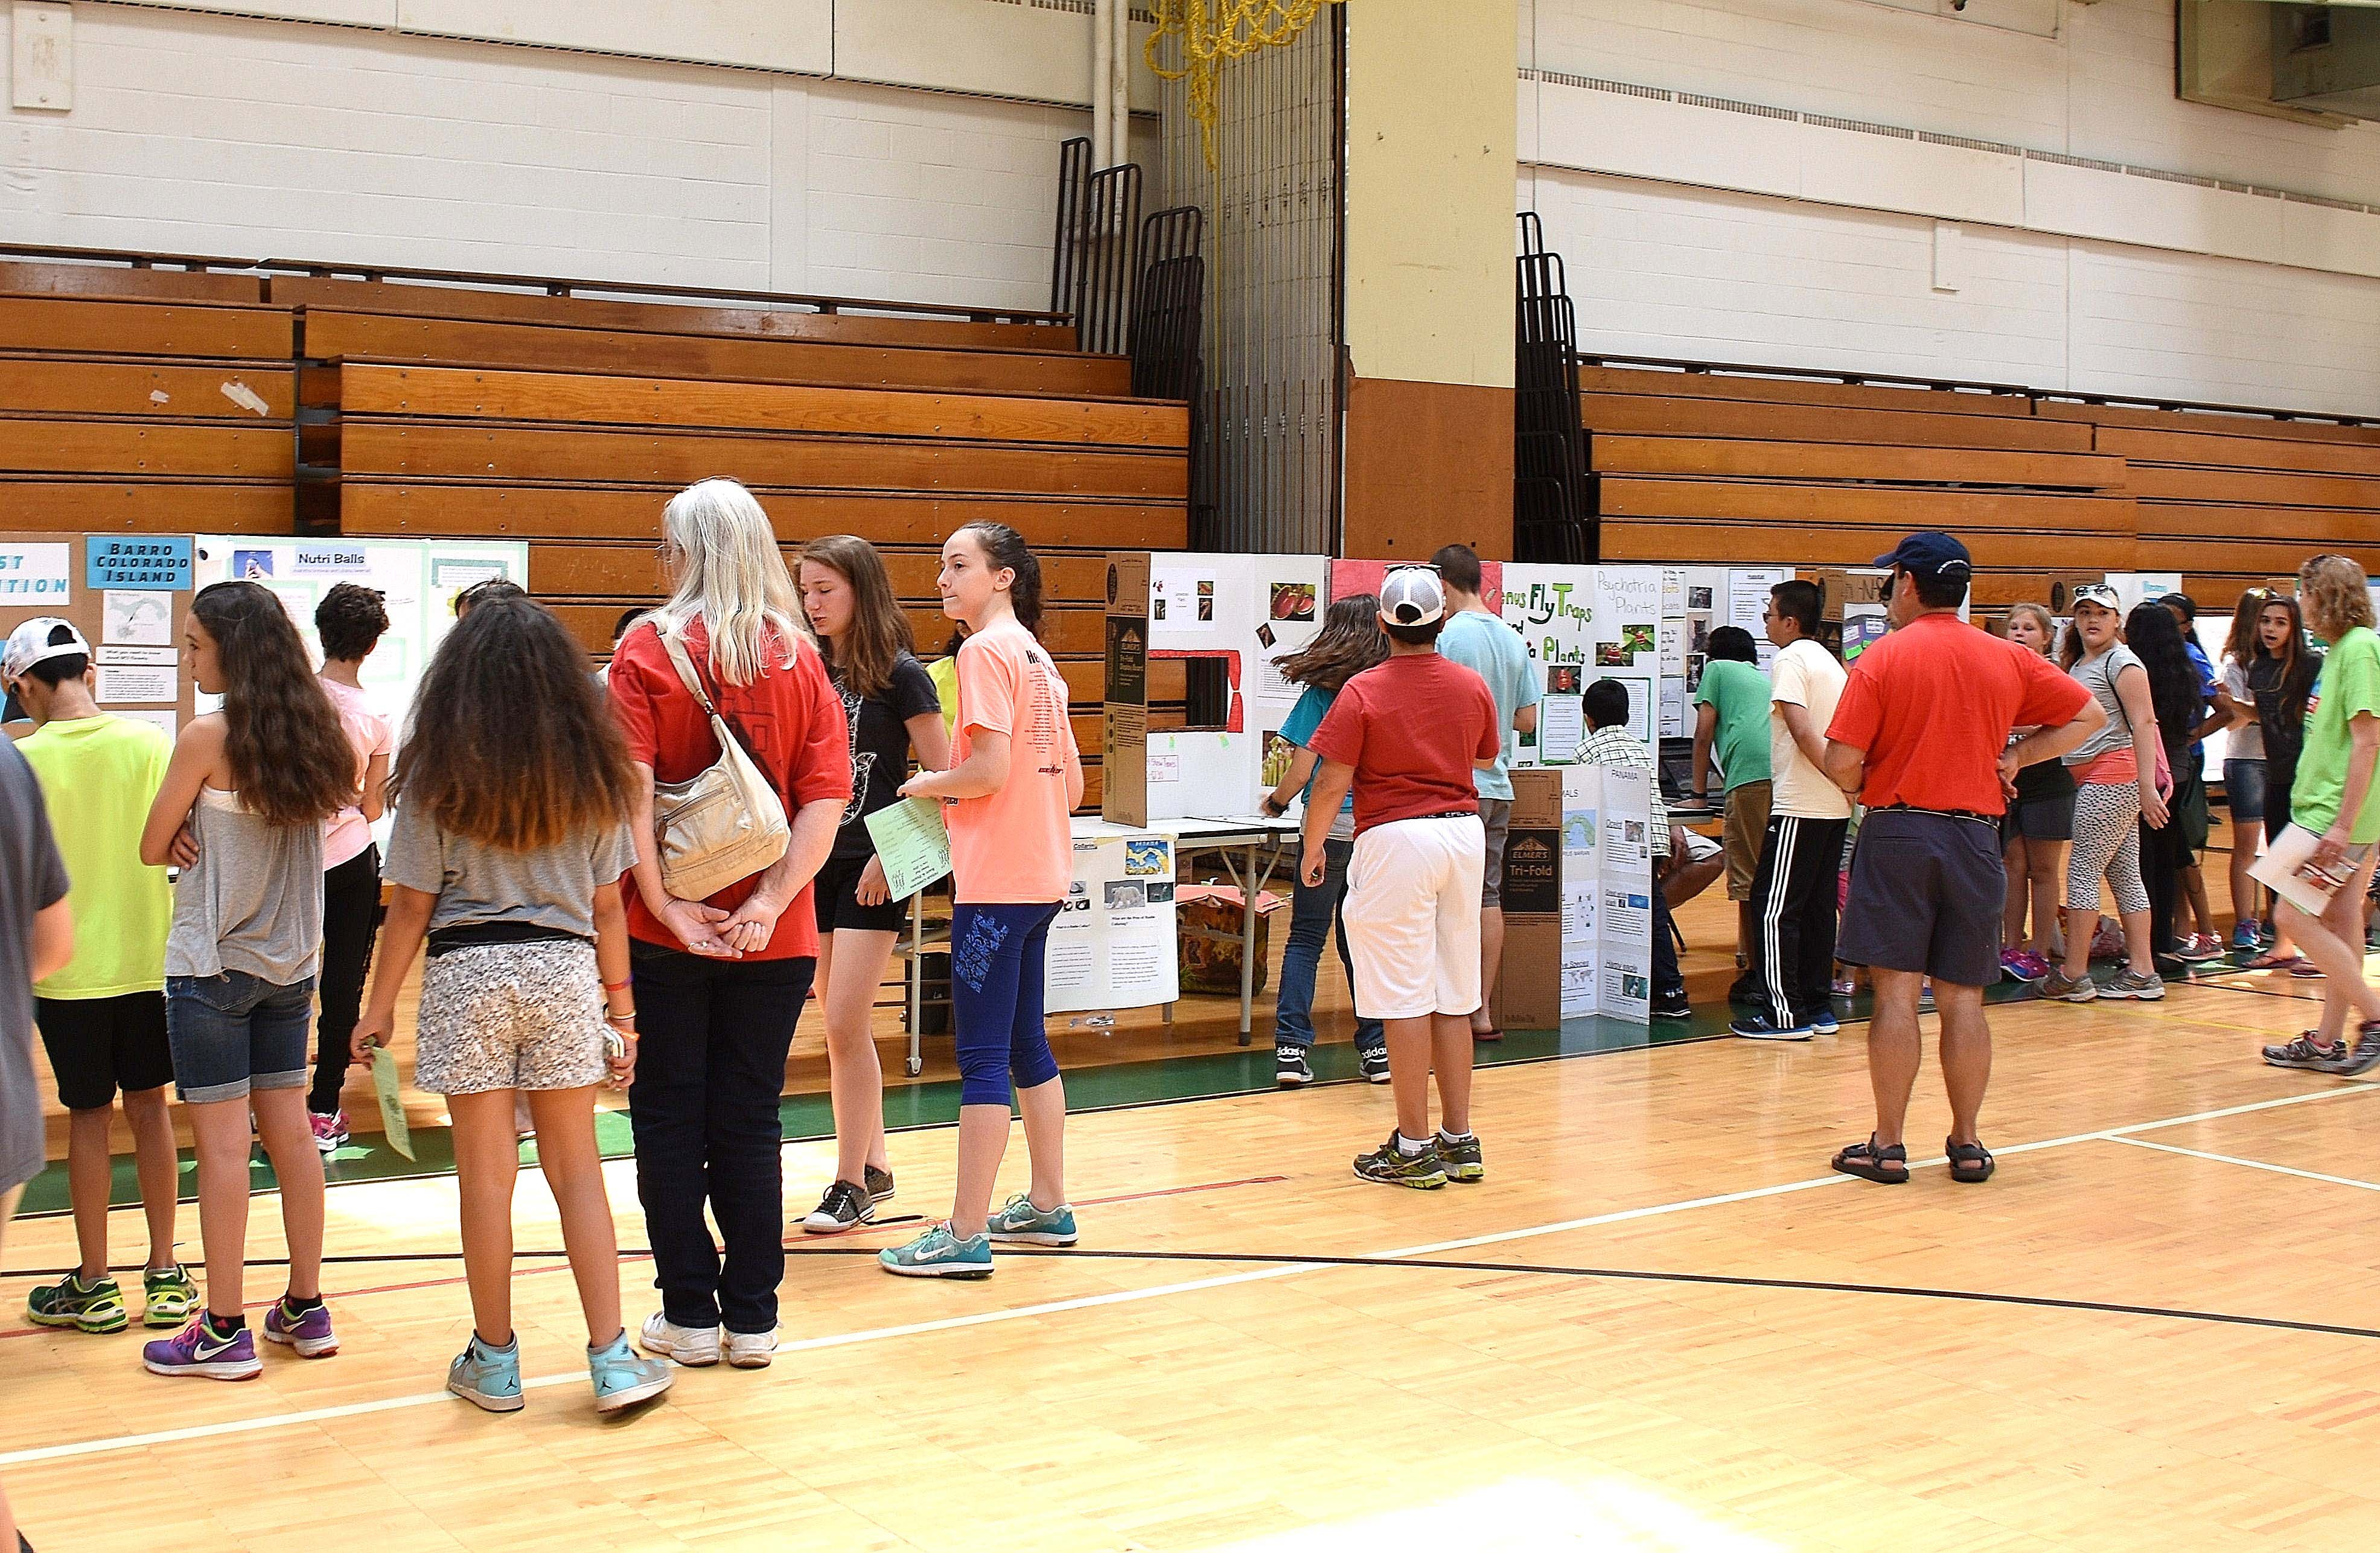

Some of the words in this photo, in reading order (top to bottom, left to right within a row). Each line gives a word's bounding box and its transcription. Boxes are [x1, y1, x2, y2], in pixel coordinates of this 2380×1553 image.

[110, 543, 173, 556] BARRO
[96, 556, 188, 568] COLORADO
[299, 553, 330, 564] Nutri
[334, 553, 365, 564] Balls
[106, 570, 176, 582] ISLAND
[0, 579, 67, 593] TION
[1528, 584, 1555, 625] Fly
[1552, 583, 1592, 631] Traps
[1616, 596, 1656, 614] Plants
[1543, 636, 1586, 665] Plants
[1611, 768, 1638, 780] PANAMA
[1510, 864, 1552, 876] Tri-Fold
